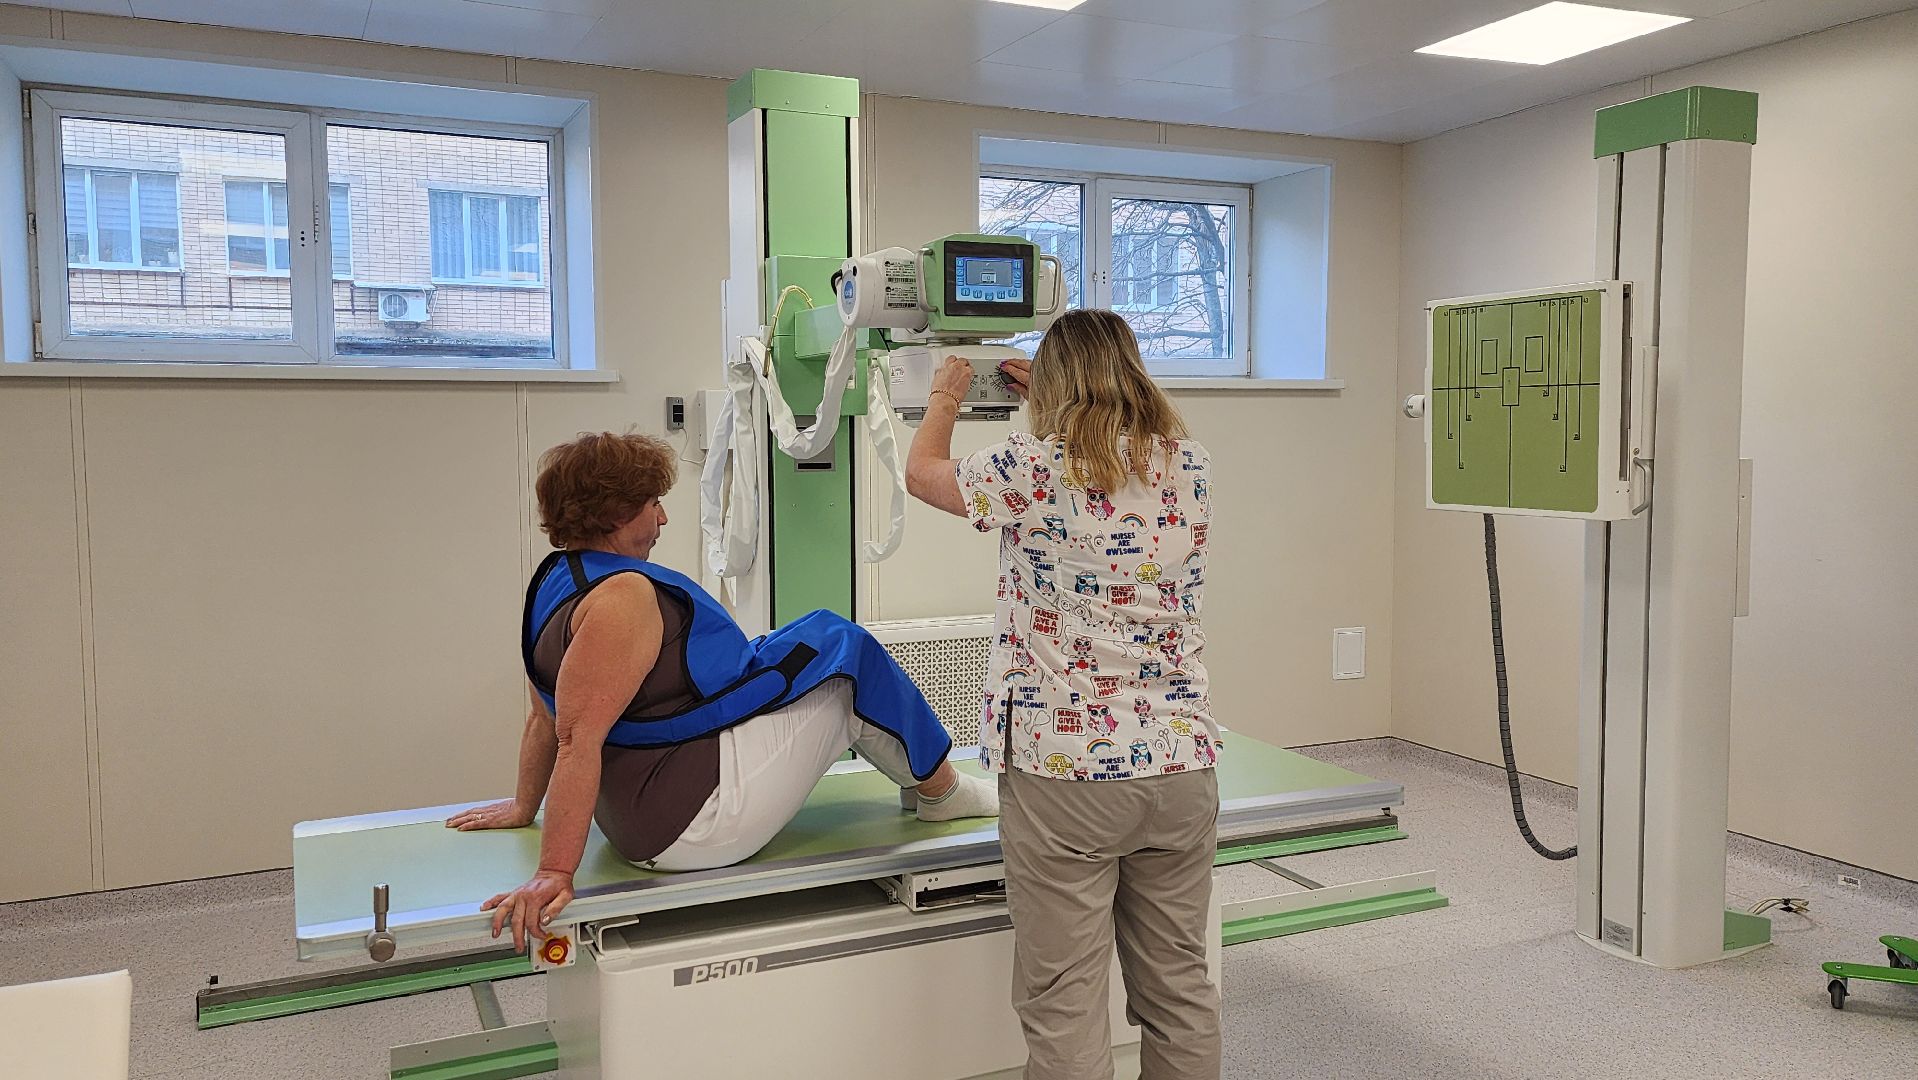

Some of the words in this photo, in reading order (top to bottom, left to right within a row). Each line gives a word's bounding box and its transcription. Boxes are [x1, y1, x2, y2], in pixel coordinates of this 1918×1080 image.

[1110, 532, 1136, 541] NURSES
[1022, 546, 1047, 557] NURSES
[1105, 547, 1144, 556] OWLSOME!
[1029, 555, 1041, 563] ARE
[1111, 596, 1136, 605] HOOT!
[1034, 608, 1059, 621] NURSES
[1034, 615, 1050, 626] GIVE
[1051, 620, 1057, 628] A
[1032, 621, 1058, 636] HOOT!
[1057, 710, 1082, 718] NURSES
[1058, 717, 1075, 725] GIVE
[1076, 717, 1082, 726] A
[1056, 724, 1084, 734] HOOT!
[1098, 756, 1126, 765] NURSES
[1105, 763, 1120, 772] ARE
[1163, 763, 1186, 774] NURSES
[1092, 771, 1134, 781] OWLSOME!
[691, 956, 758, 986] P500
